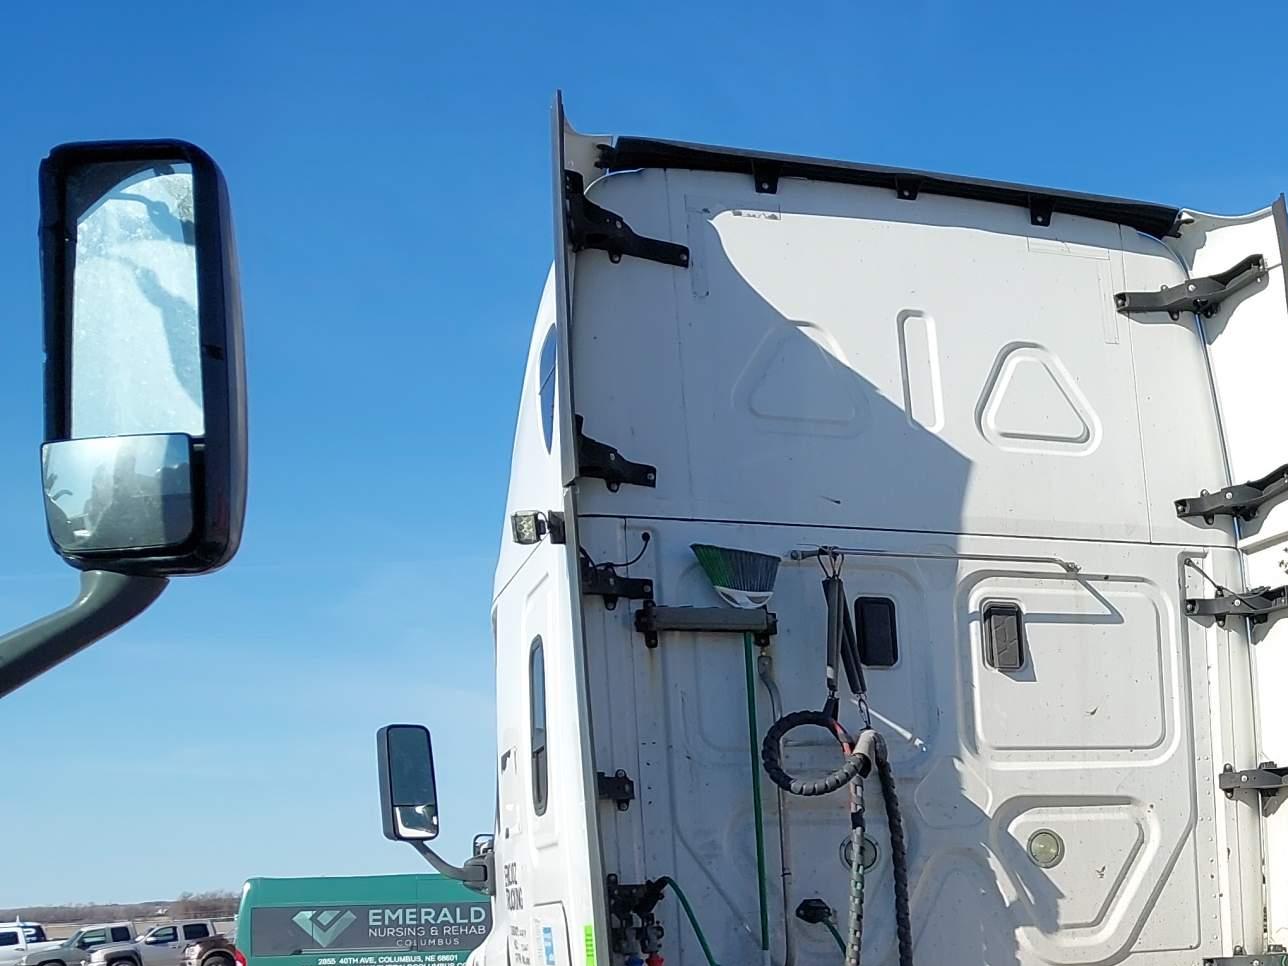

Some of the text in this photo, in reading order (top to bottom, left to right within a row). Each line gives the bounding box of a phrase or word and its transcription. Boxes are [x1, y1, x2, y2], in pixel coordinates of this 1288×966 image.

[369, 907, 486, 926] EMERALD
[369, 925, 486, 937] NURSING & REHAB
[396, 938, 460, 946] COLUMBUS
[339, 957, 358, 965] 40TH
[378, 955, 423, 963] COLUMBUS,
